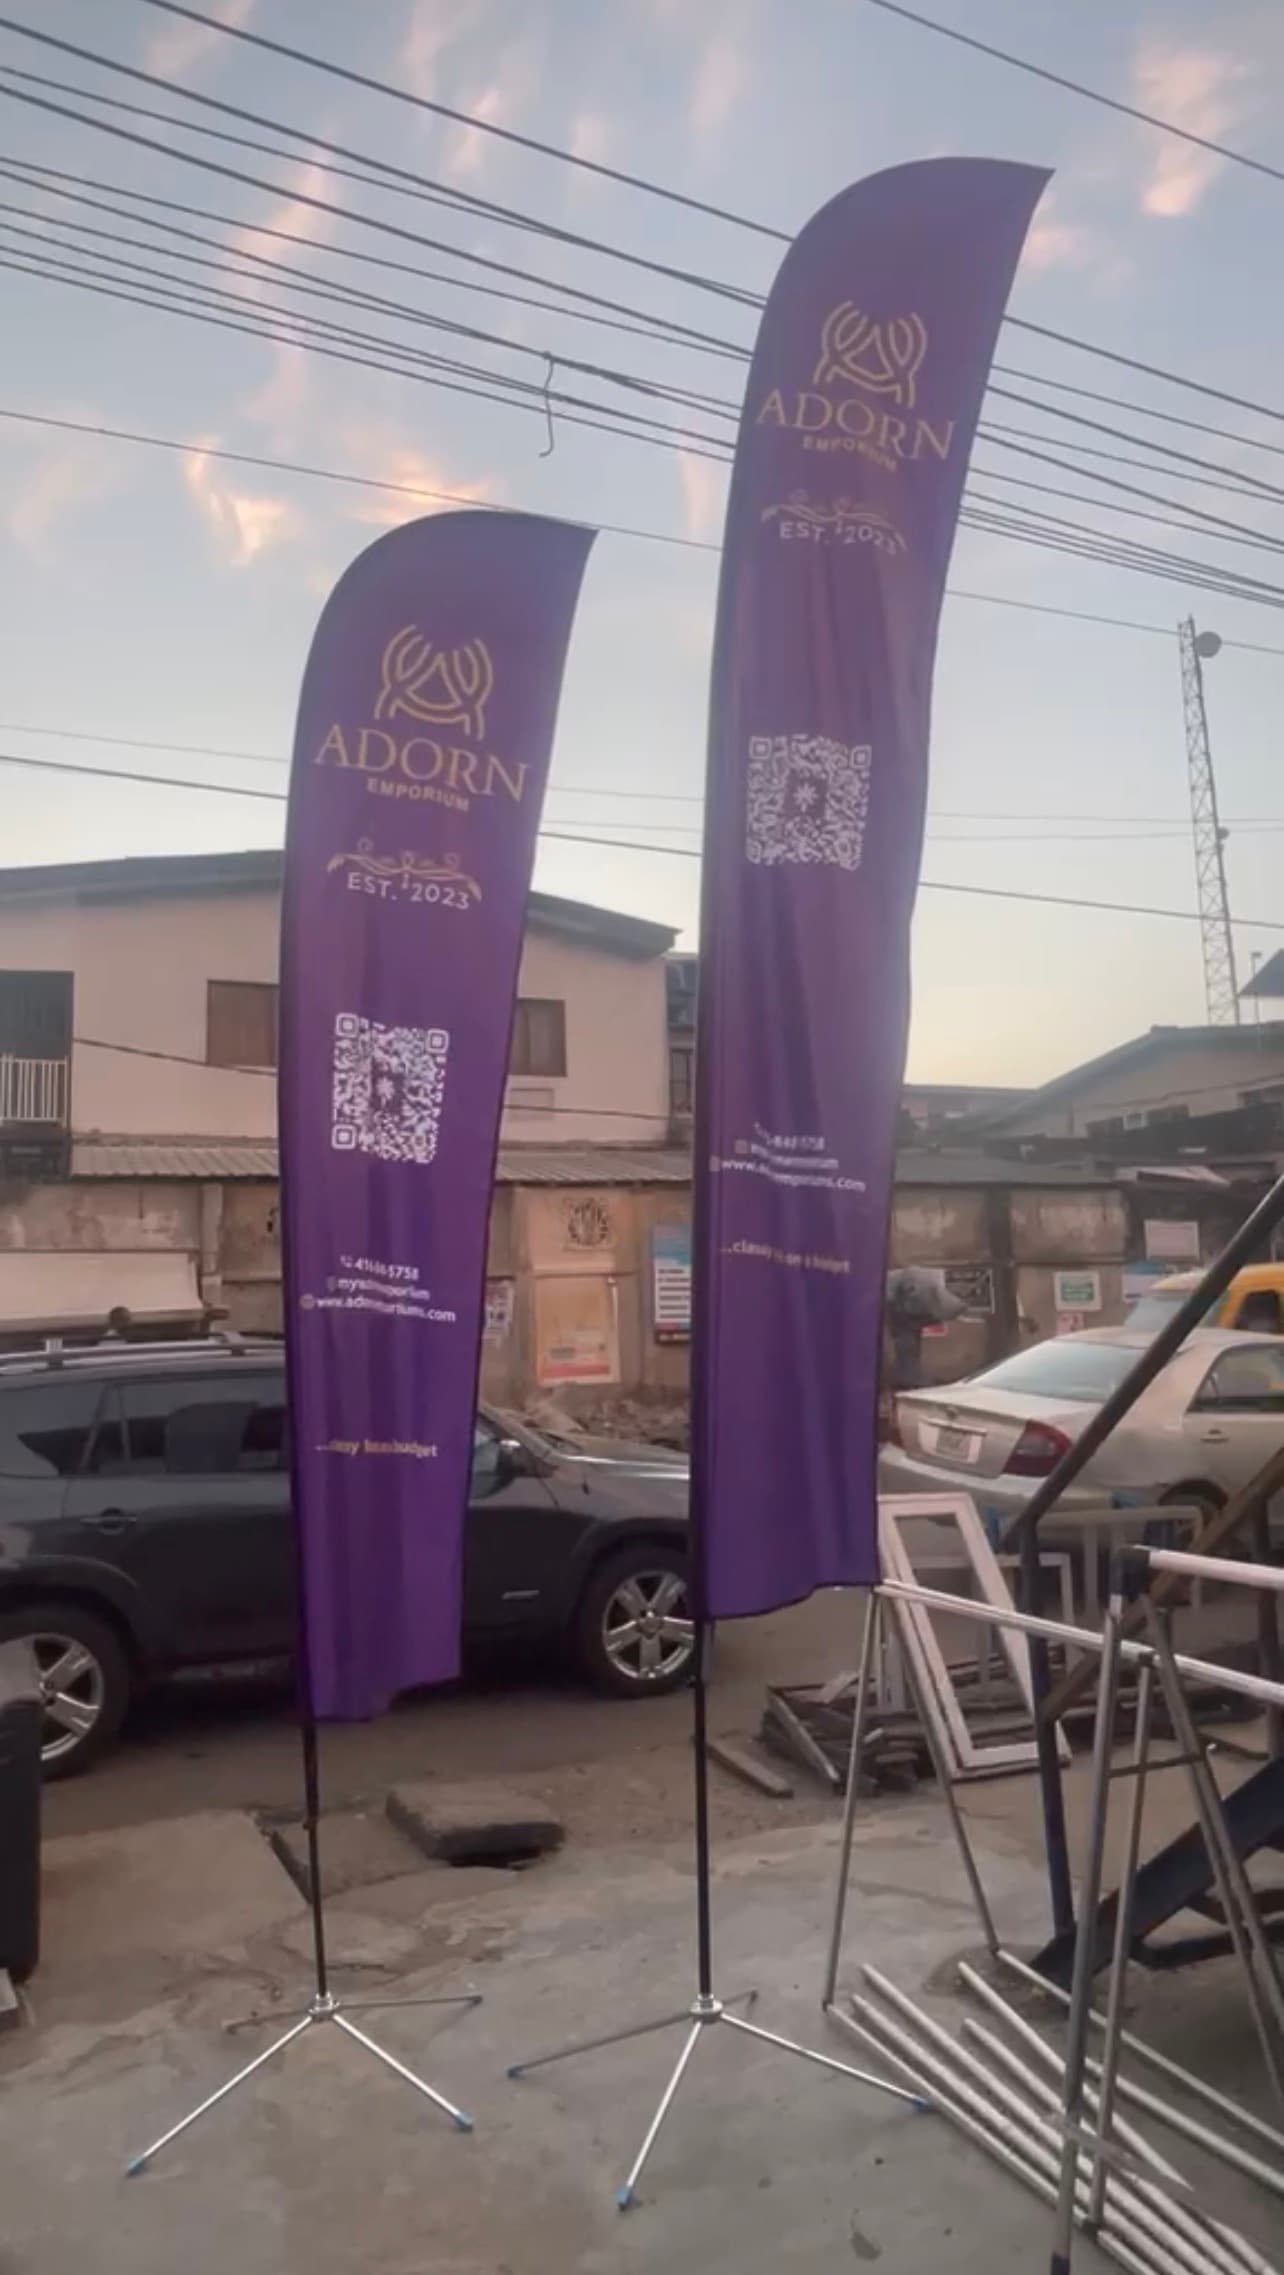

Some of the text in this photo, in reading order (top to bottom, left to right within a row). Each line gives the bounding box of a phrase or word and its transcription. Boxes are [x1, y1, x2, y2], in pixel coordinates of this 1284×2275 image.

[756, 387, 958, 461] ADORN
[313, 723, 531, 803] ADORN
[366, 777, 470, 813] EMPORIUM
[346, 871, 471, 910] EST. 2023
